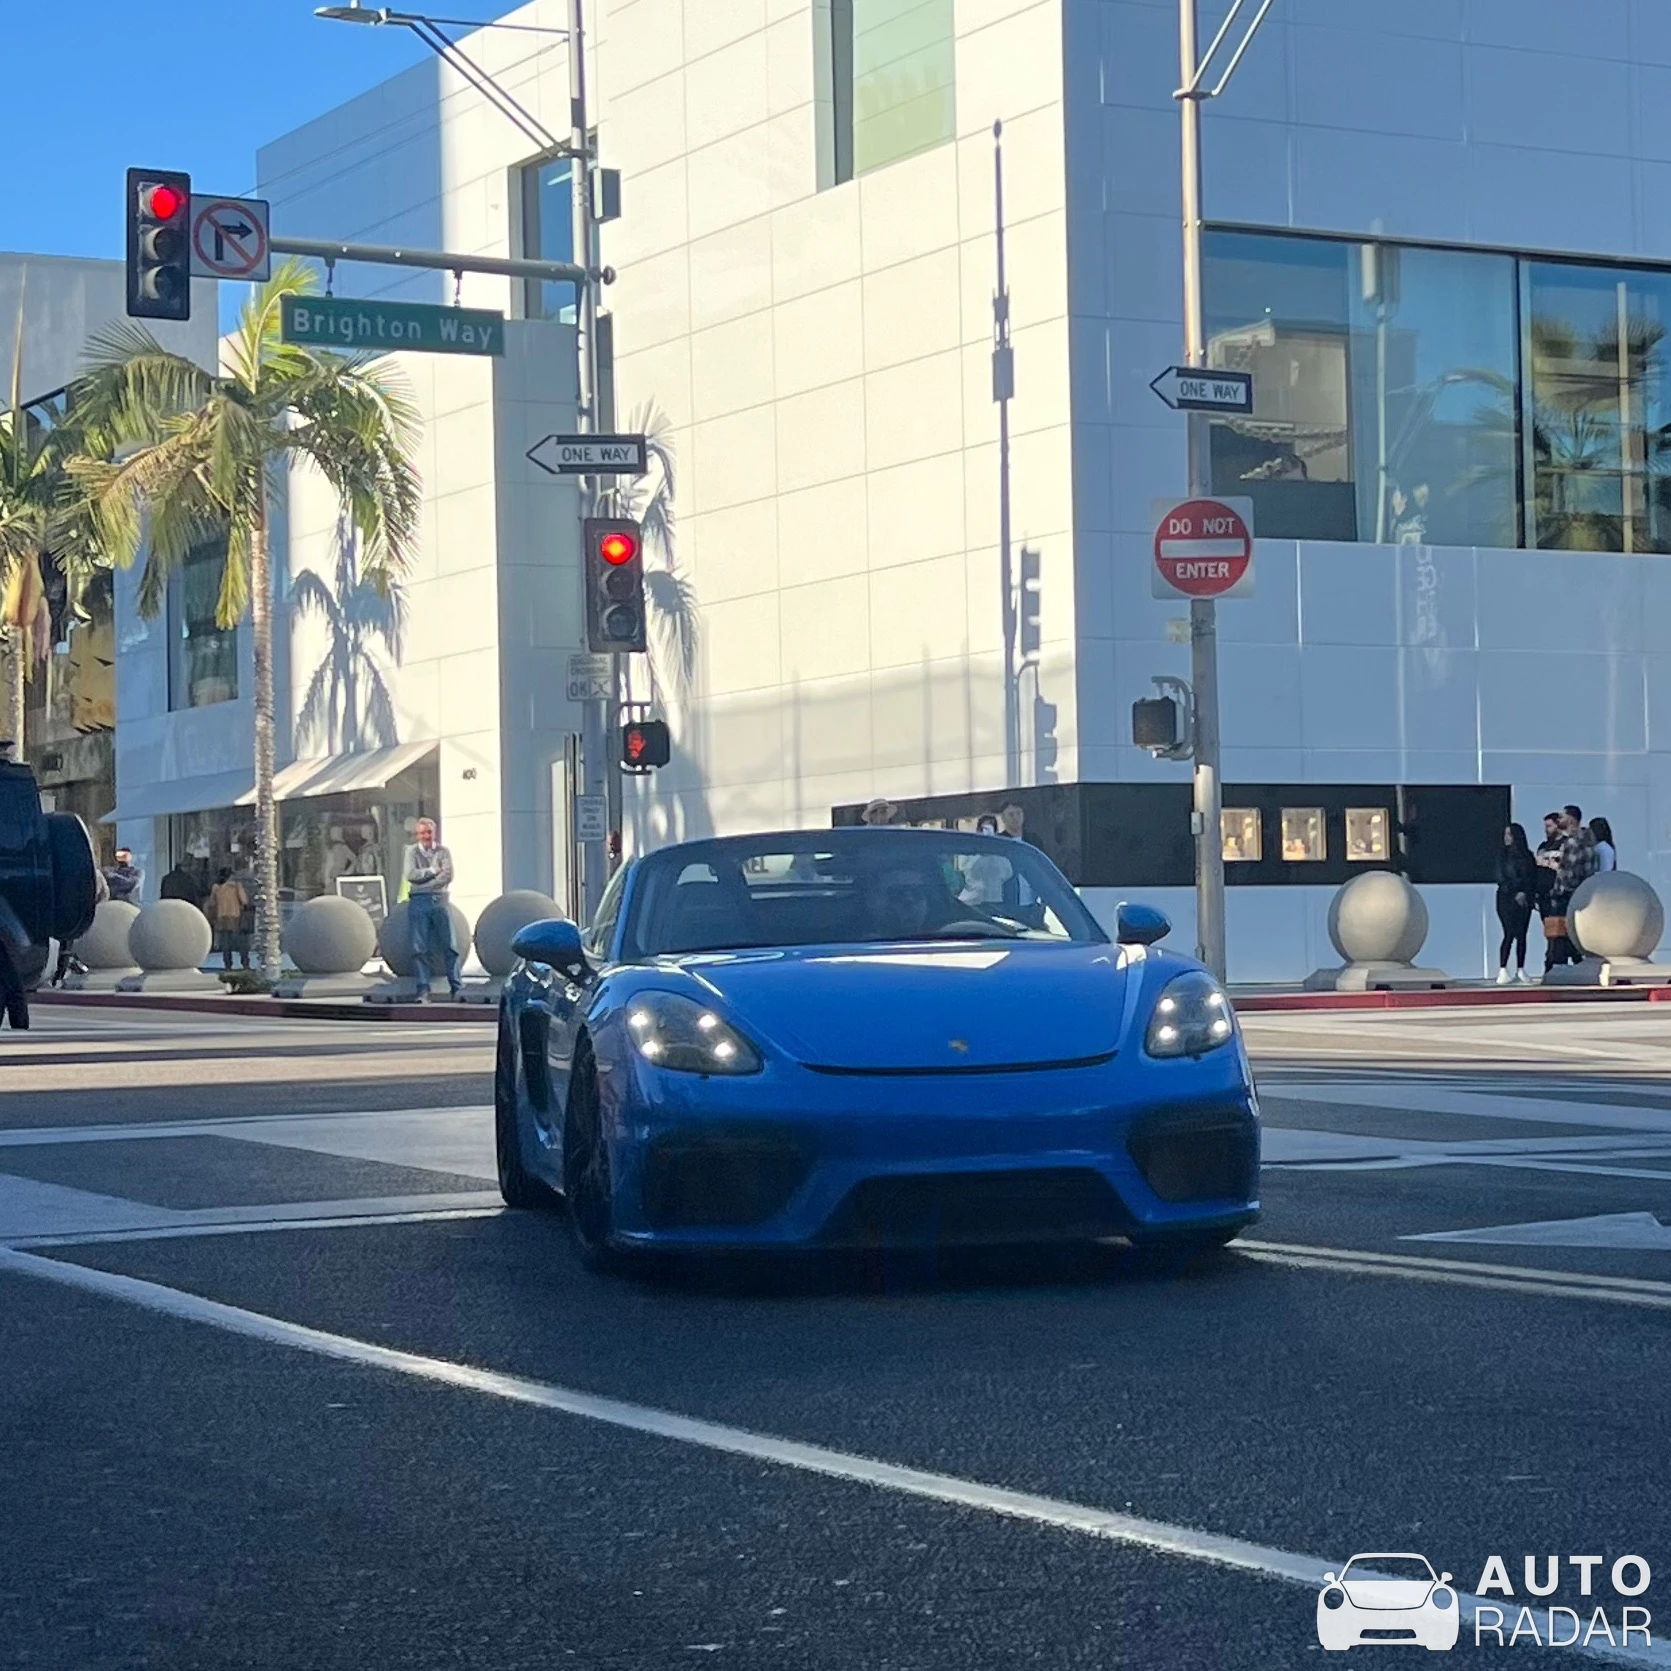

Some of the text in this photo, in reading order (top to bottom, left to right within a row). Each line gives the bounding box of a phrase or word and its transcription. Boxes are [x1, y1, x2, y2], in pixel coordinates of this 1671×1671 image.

[293, 309, 493, 350] Brighton Way
[1180, 380, 1241, 399] ONE WAY
[561, 446, 631, 462] ONE WAY
[1169, 517, 1236, 535] DO NOT
[1176, 562, 1230, 579] ENTER
